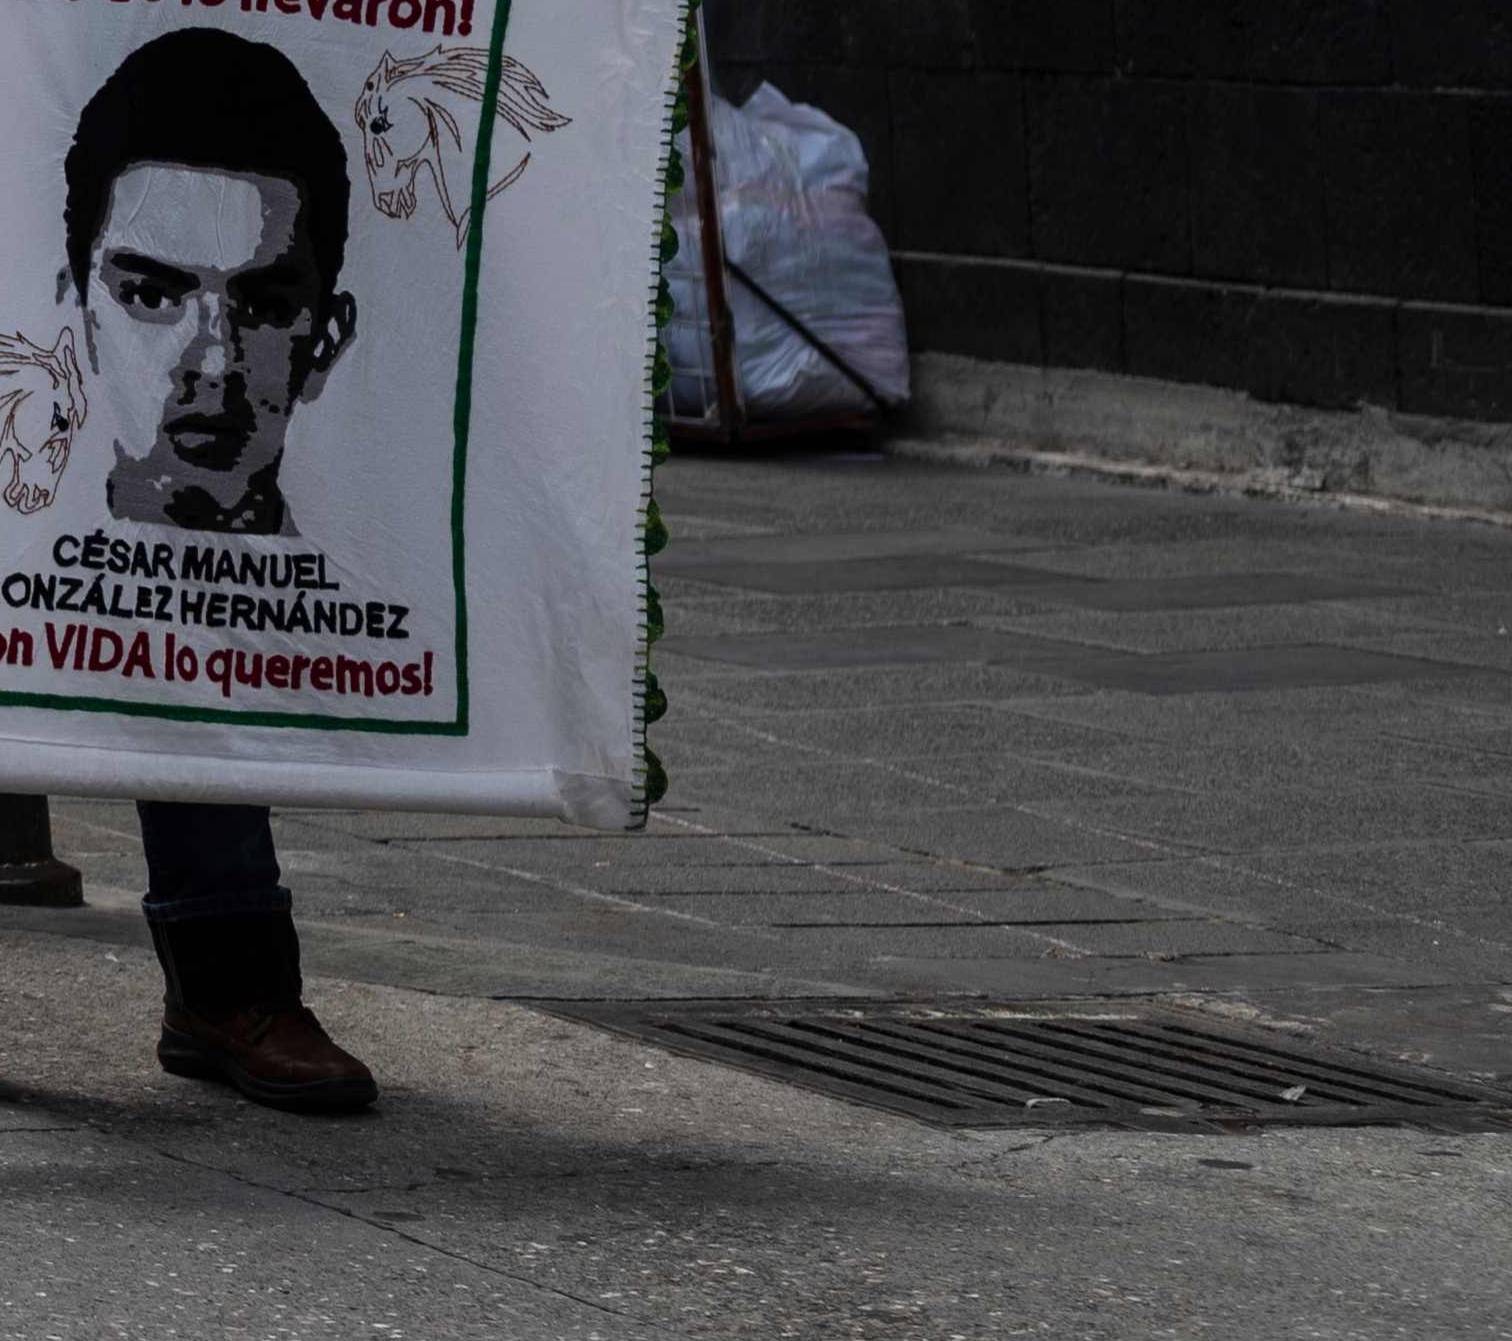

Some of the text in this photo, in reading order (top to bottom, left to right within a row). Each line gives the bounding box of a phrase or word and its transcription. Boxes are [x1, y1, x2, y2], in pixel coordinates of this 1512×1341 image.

[52, 529, 340, 591] CÉSAR MANUEL
[181, 590, 410, 640] HERNÁNDEZ
[44, 622, 156, 679] VIDA
[164, 632, 198, 681] lo
[205, 647, 434, 698] queremos!
